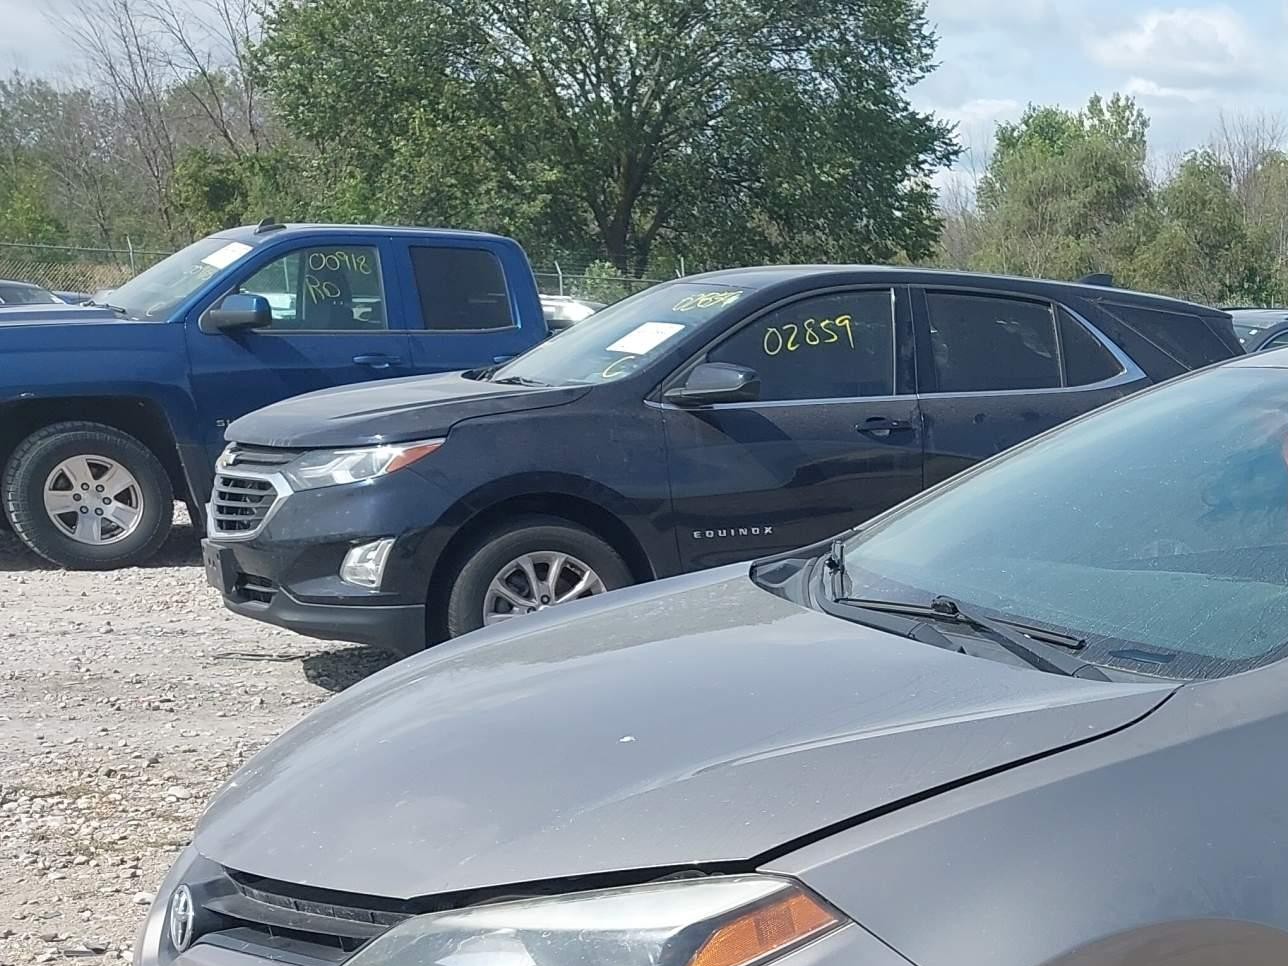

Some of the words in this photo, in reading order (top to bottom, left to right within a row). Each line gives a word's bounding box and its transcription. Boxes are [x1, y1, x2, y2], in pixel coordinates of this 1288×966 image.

[309, 251, 372, 274] 00918
[763, 314, 855, 356] 02859
[693, 526, 773, 538] EQUINOX
